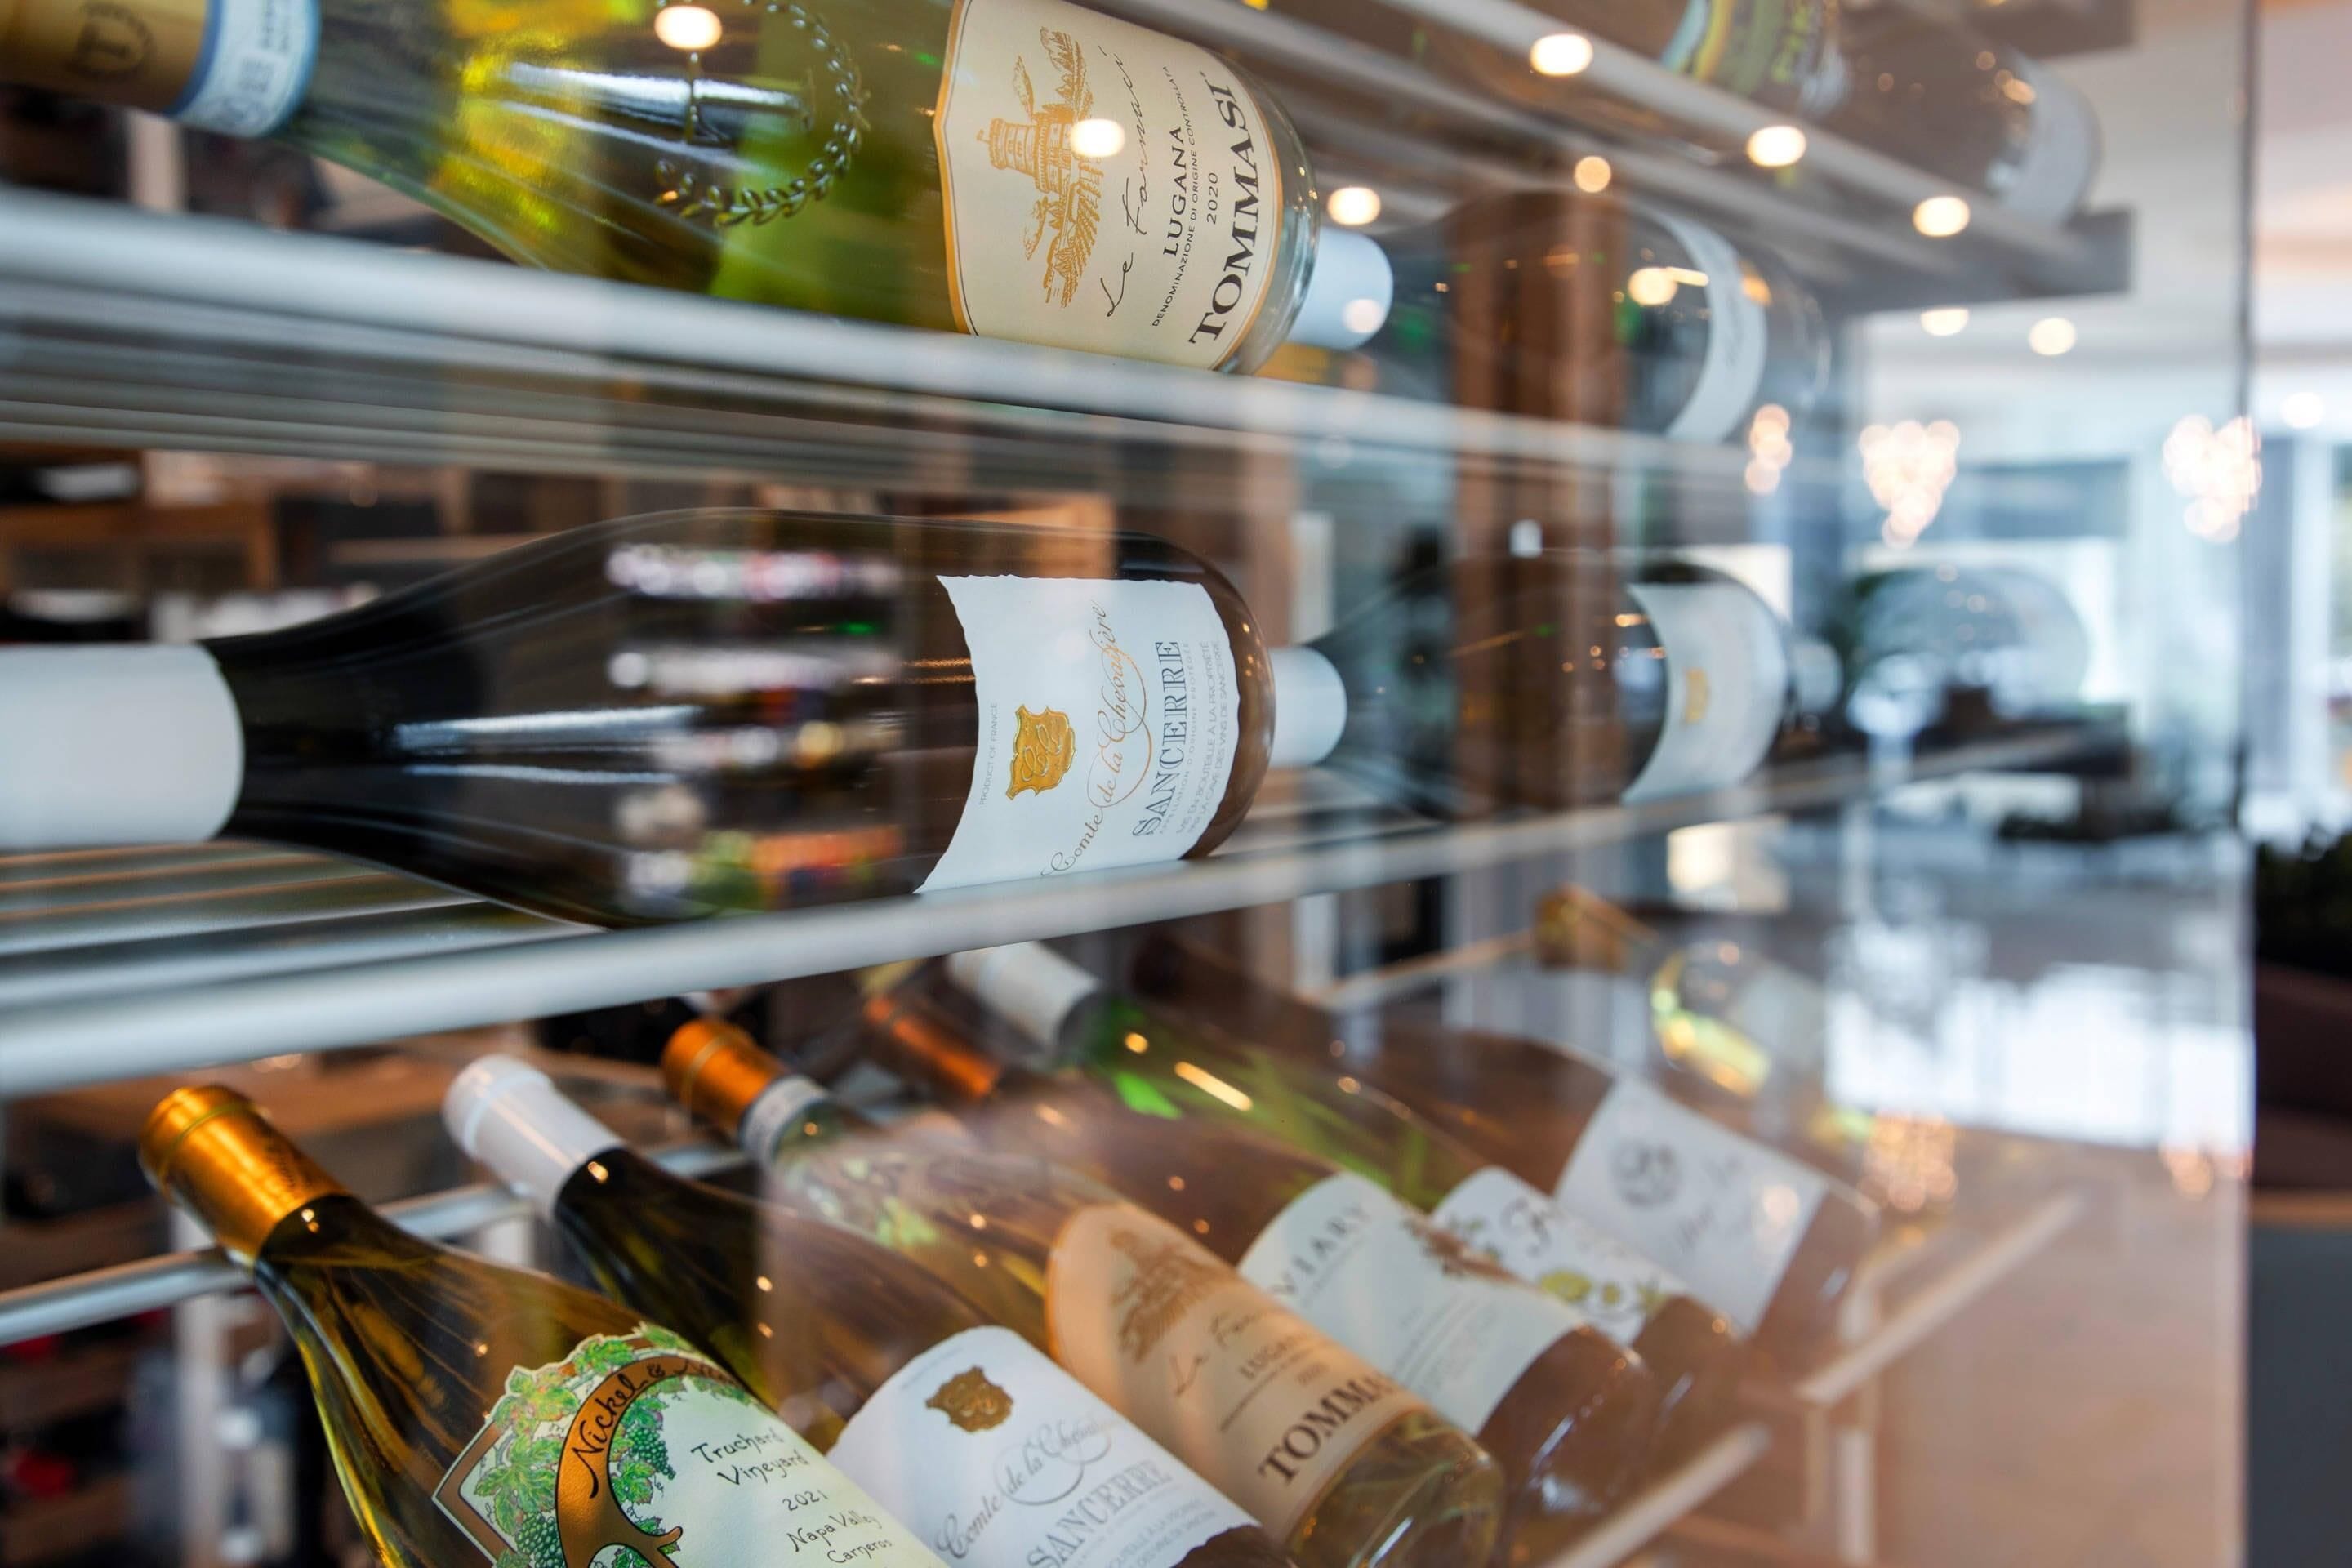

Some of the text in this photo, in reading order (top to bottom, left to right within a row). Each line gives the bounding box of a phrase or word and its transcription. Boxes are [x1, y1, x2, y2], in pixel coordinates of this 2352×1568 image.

[1152, 66, 1199, 327] DENOMINAZIONE DI ORIGINE CONTROLLATA
[1162, 126, 1187, 256] LUGANA
[1188, 79, 1259, 344] TOMMASI
[1206, 172, 1218, 225] 2020
[1100, 252, 1134, 317] Le
[1133, 641, 1187, 836] SANCERRE
[1220, 704, 1227, 718] DE
[979, 702, 998, 806] PRODUCT OF FRANCE
[1196, 739, 1216, 796] BOUTEILLE
[1209, 707, 1217, 723] LA
[1041, 808, 1103, 876] Comte
[1097, 777, 1116, 804] de
[572, 1373, 648, 1499] Nickel
[690, 1427, 784, 1463] Truchard
[717, 1448, 810, 1485] Vineyard
[782, 1489, 829, 1512] 2021
[786, 1510, 883, 1552] Napa Valley
[826, 1539, 893, 1565] Carneros
